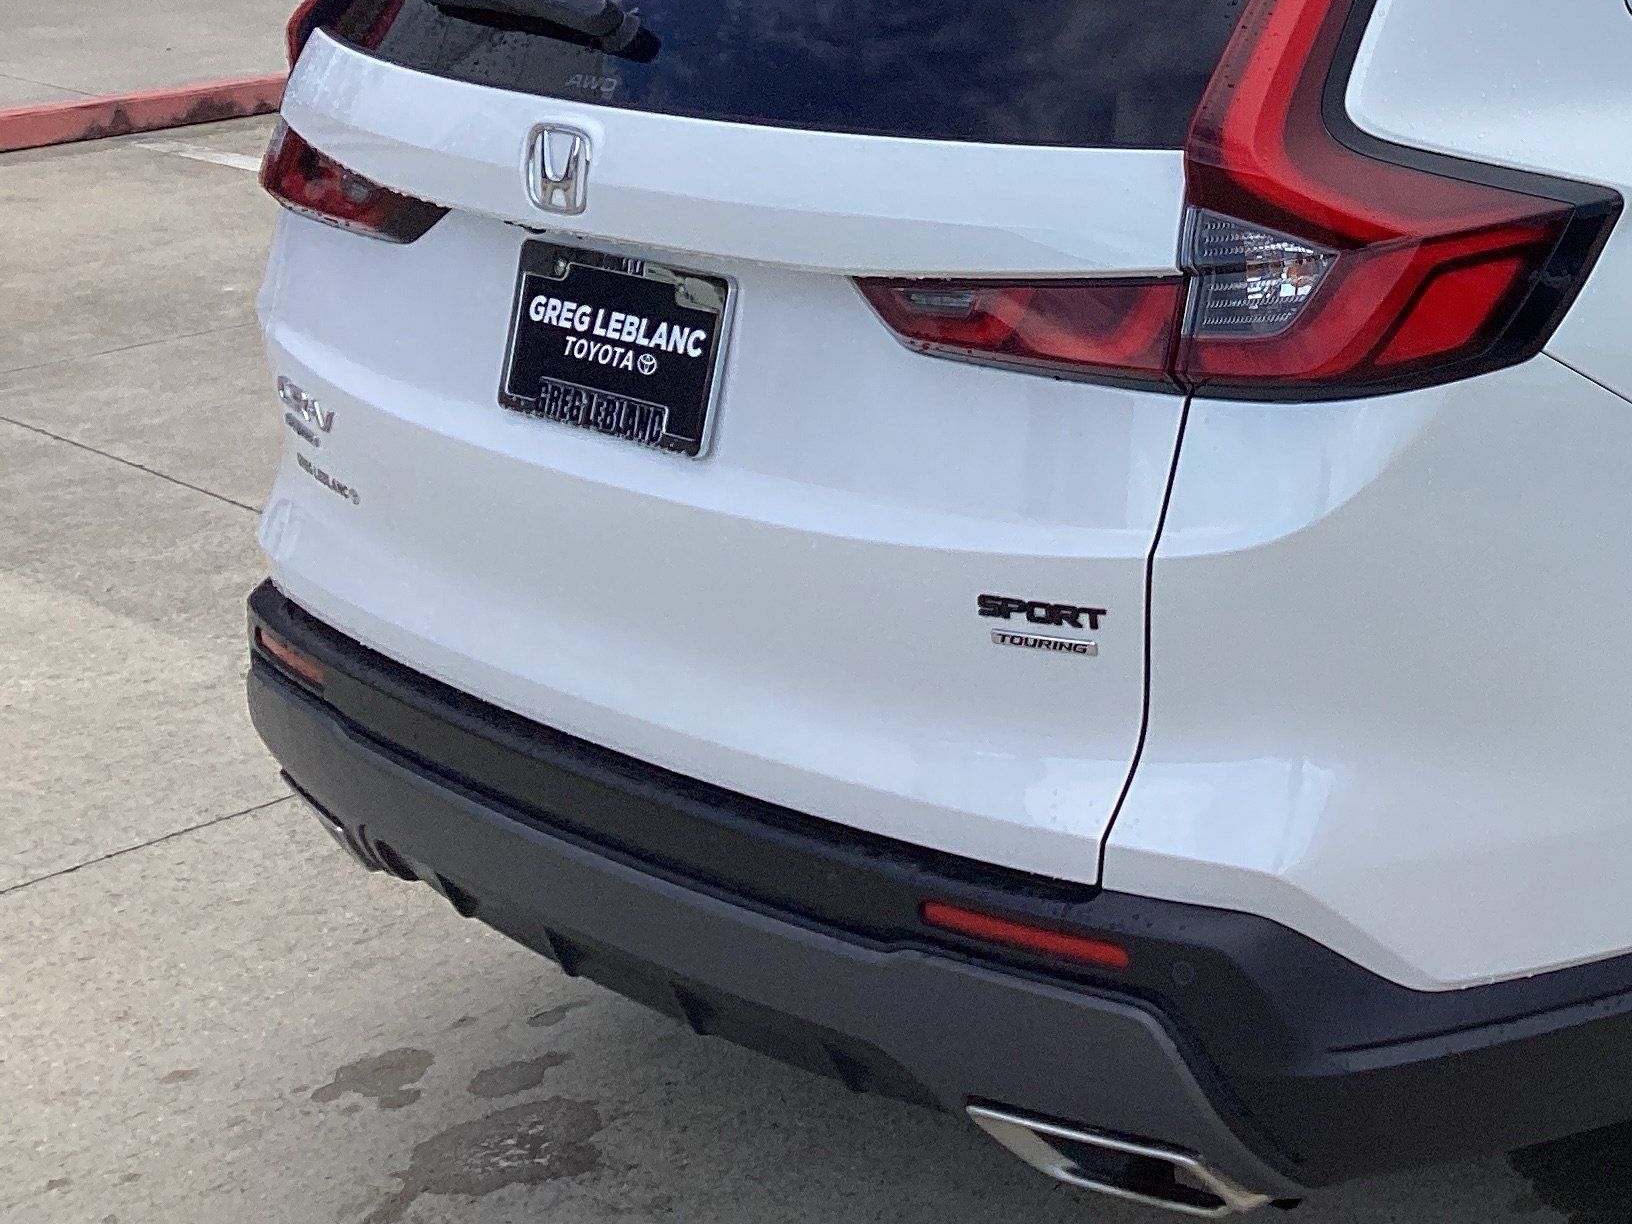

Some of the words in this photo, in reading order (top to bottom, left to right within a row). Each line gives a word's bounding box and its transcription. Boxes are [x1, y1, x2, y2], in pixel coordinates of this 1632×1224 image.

[529, 295, 591, 332] GREG
[592, 309, 707, 357] LEBLANC
[564, 336, 635, 371] TOYOTA
[977, 594, 1107, 630] SPORT
[1000, 634, 1087, 654] TOURING
